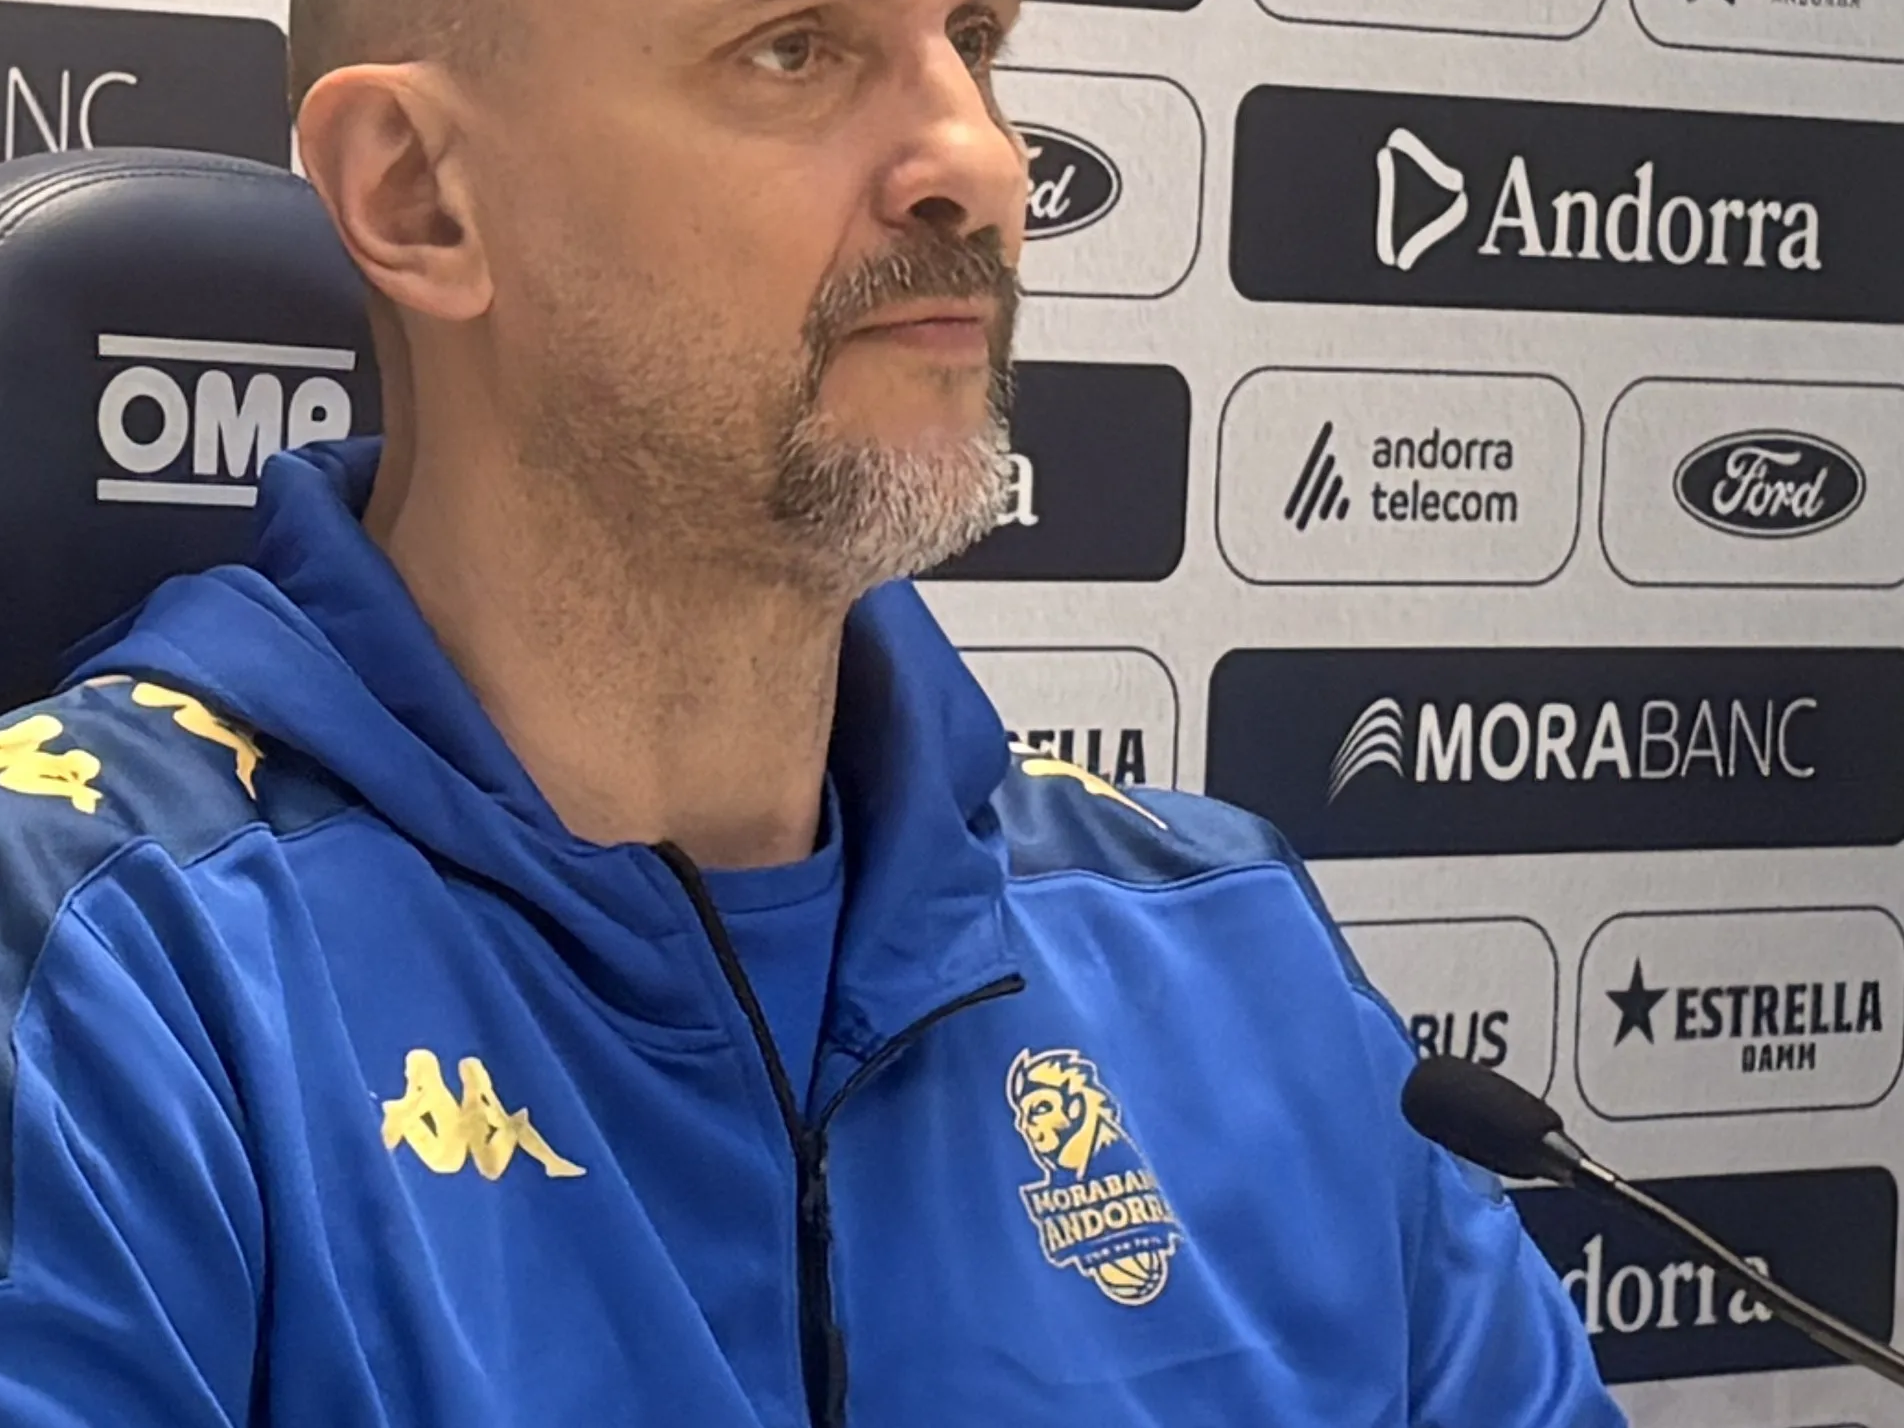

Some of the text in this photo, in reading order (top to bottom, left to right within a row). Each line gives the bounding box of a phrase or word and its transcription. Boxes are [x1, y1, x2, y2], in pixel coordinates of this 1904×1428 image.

[1479, 156, 1821, 269] Andorra
[1373, 428, 1513, 470] andorra
[1372, 480, 1517, 522] telecom
[1713, 451, 1826, 517] Ford
[1416, 699, 1816, 781] MORABANC
[1676, 981, 1882, 1040] ESTRELLA
[1742, 1043, 1815, 1072] DAMM
[1561, 1233, 1774, 1334] dorra
